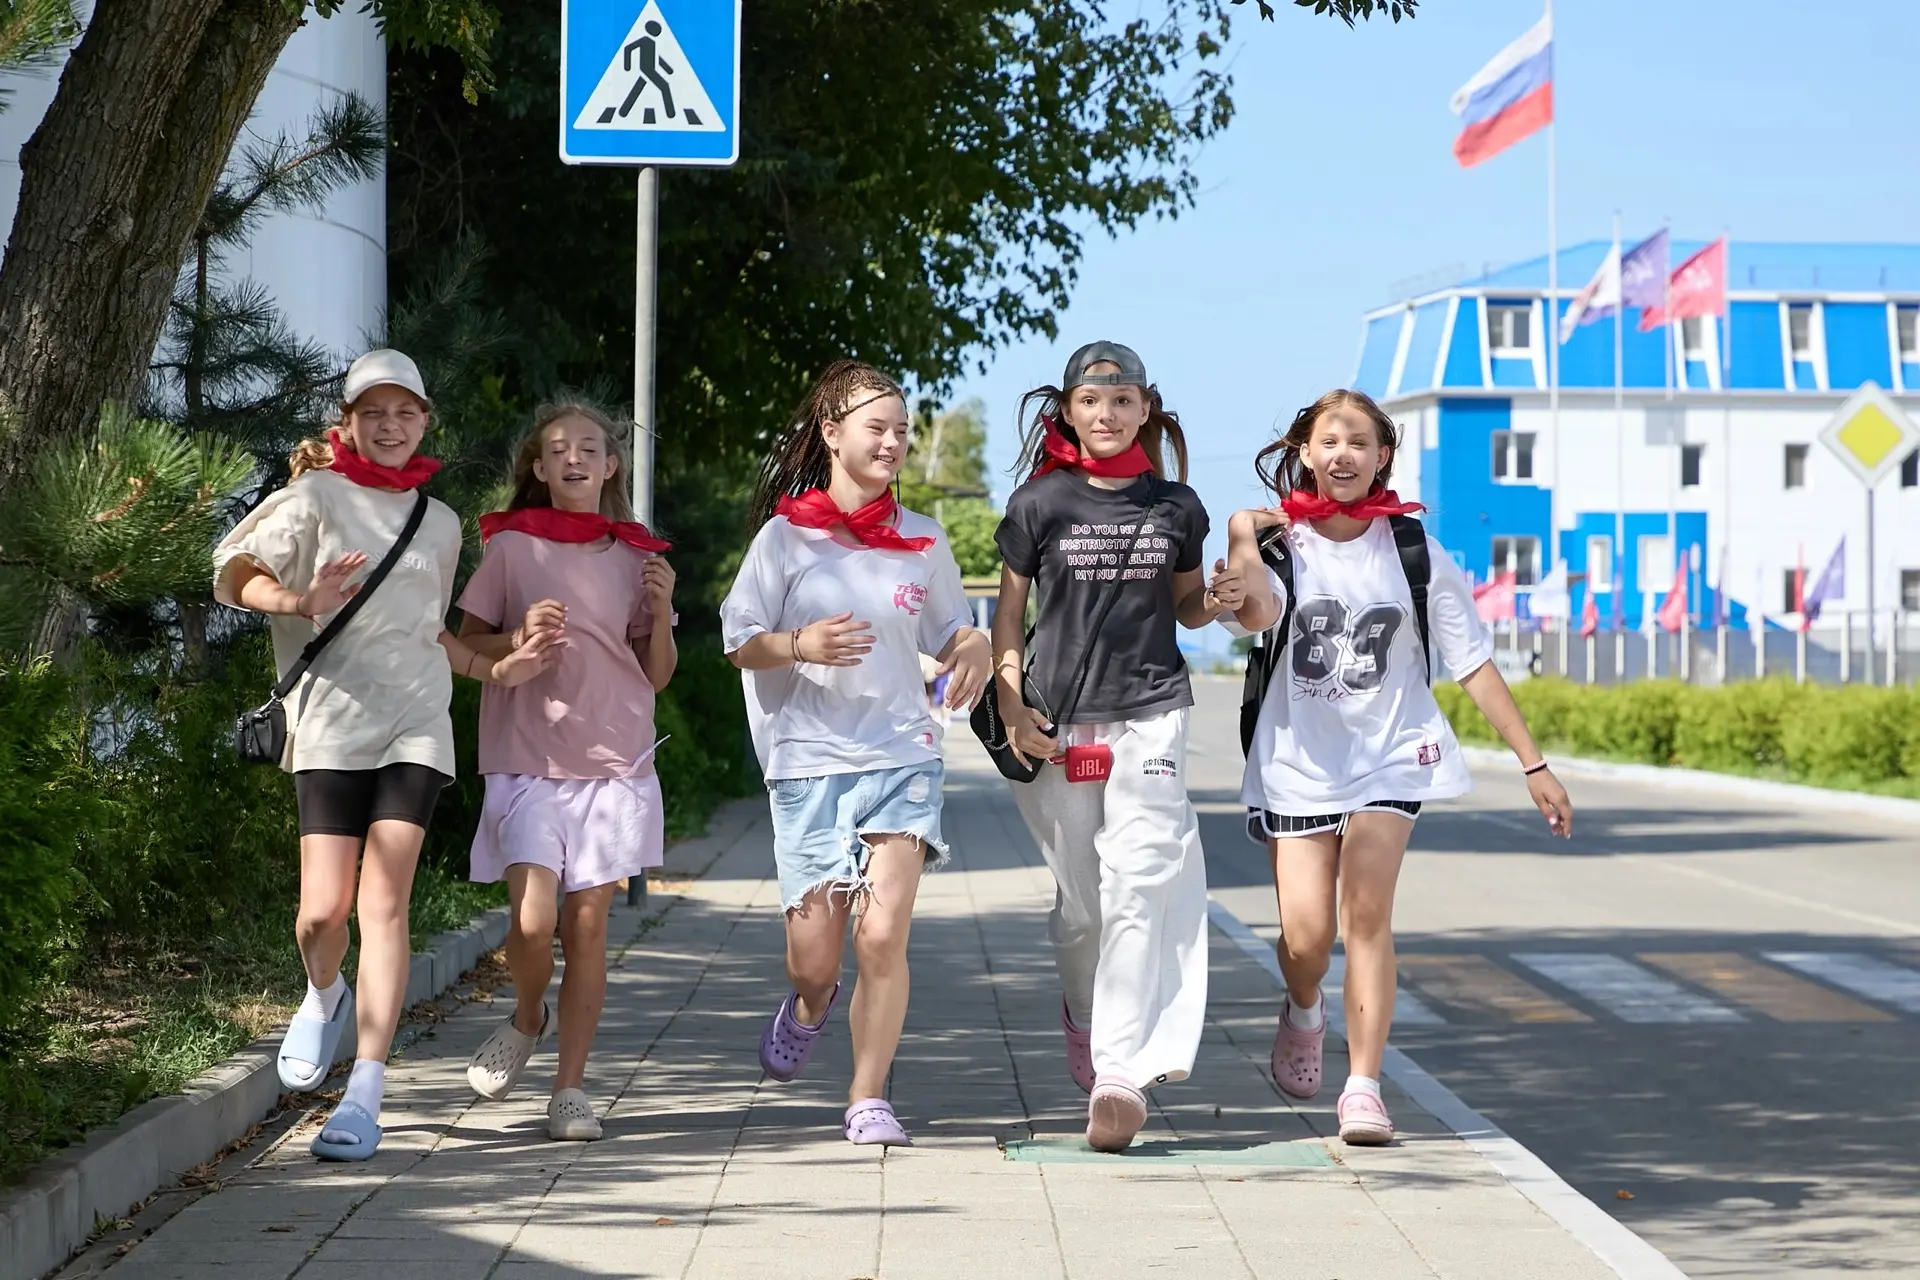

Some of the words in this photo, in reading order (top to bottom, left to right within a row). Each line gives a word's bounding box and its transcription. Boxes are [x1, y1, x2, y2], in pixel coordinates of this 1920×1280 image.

[1072, 524, 1091, 535] DO
[1092, 524, 1118, 536] YOU
[1152, 538, 1168, 549] ON
[1068, 554, 1098, 565] HOW
[1101, 554, 1117, 565] TO
[1075, 569, 1094, 580] MY
[1076, 759, 1105, 777] JBL
